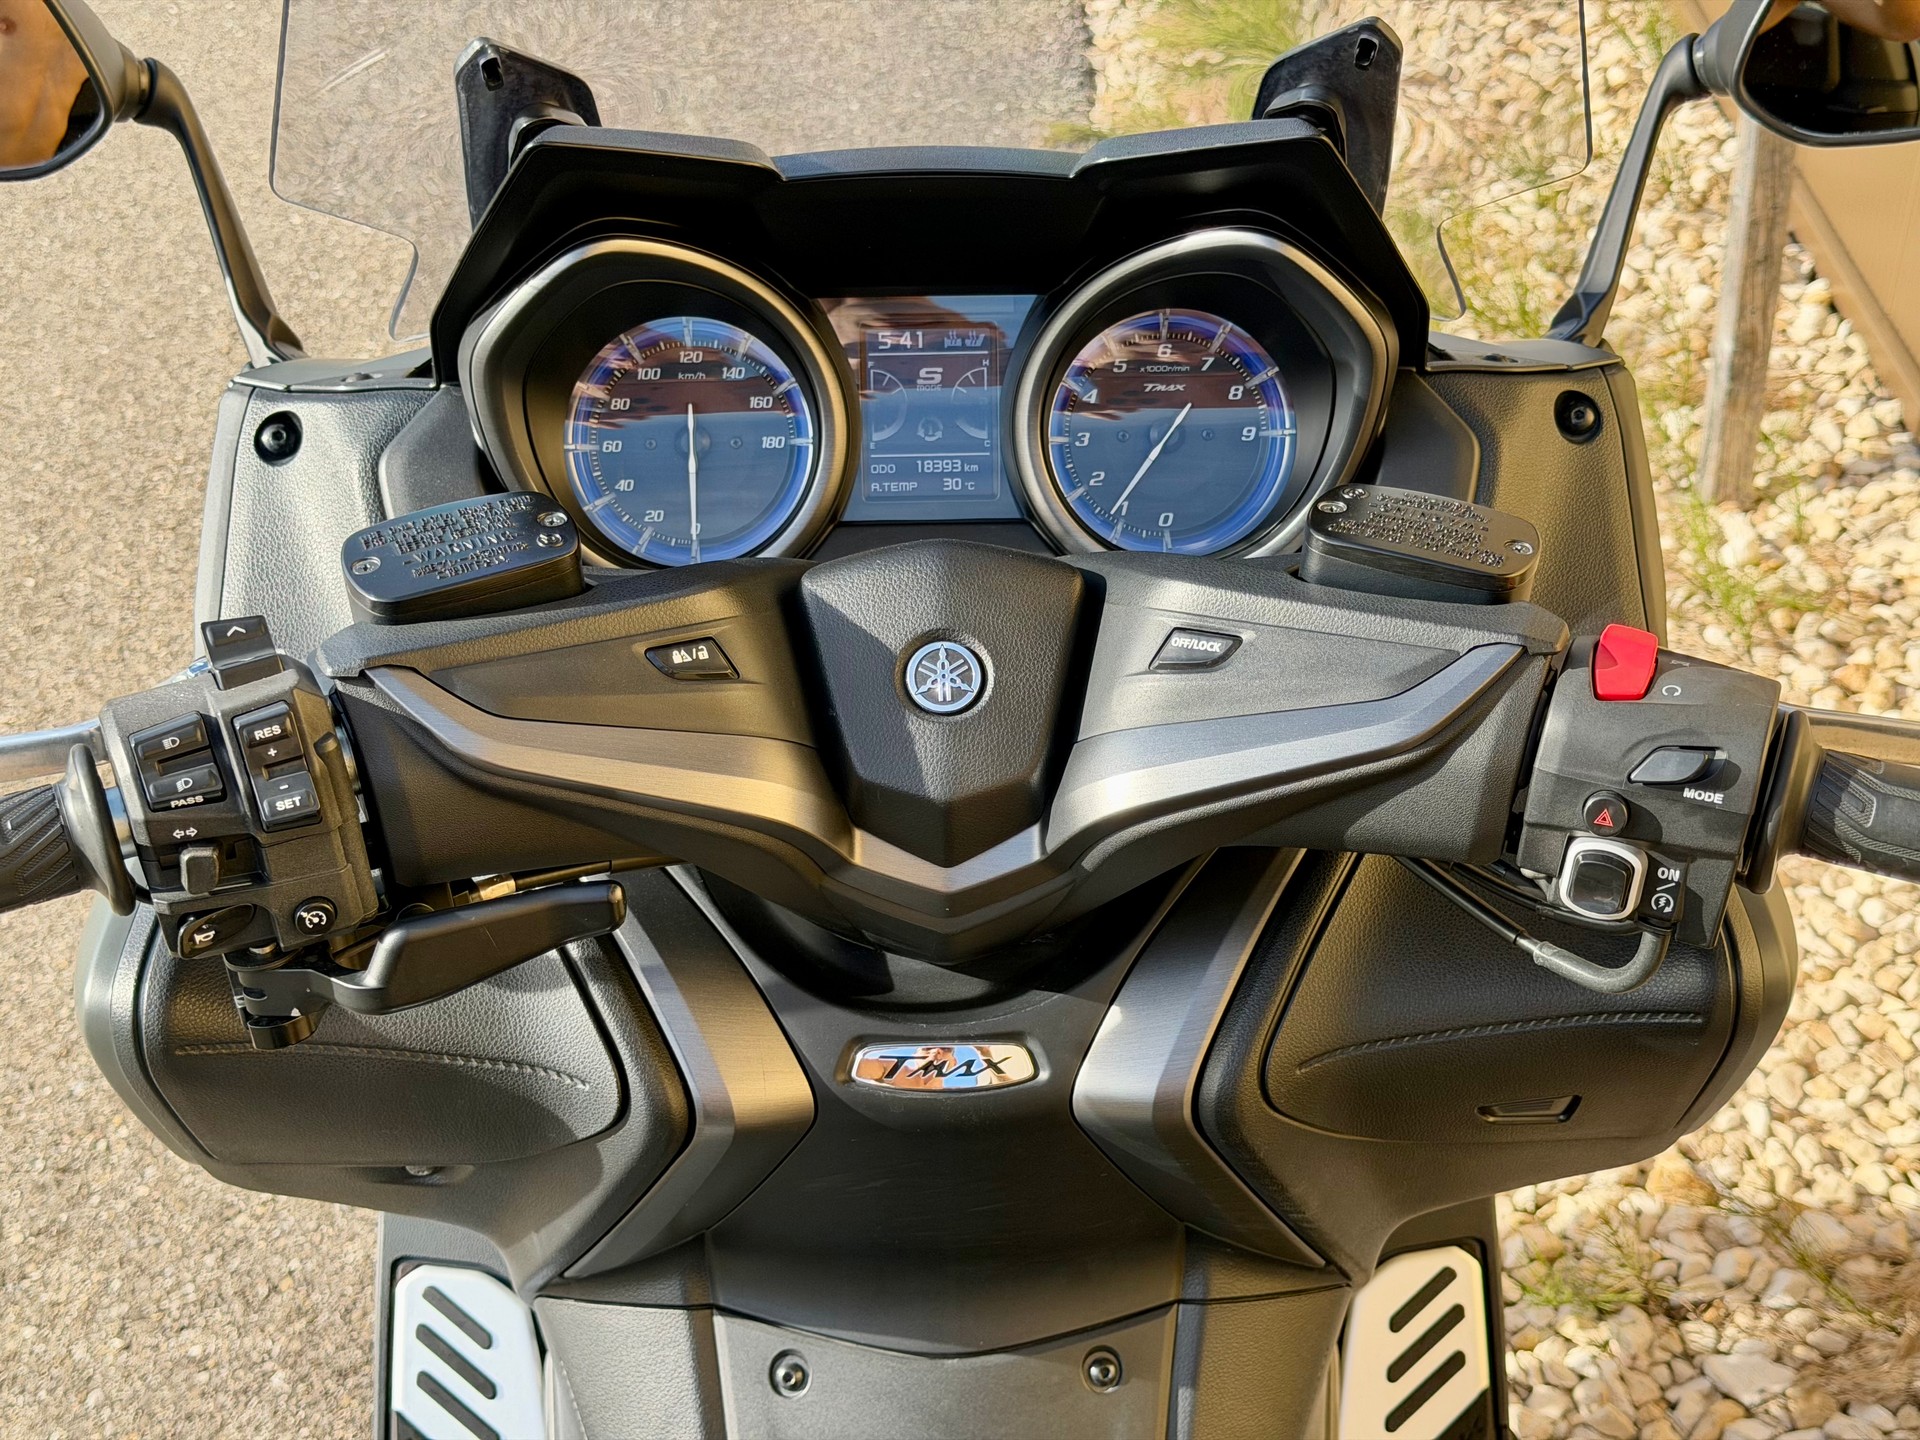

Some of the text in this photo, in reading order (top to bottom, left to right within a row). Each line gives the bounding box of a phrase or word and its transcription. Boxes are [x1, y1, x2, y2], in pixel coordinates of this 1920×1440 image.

[679, 351, 702, 364] 120
[1157, 344, 1172, 358] 6
[1112, 358, 1128, 373] 5
[1200, 357, 1216, 371] 7
[637, 368, 661, 380] 100
[678, 372, 706, 380] km/h
[722, 367, 745, 380] 140
[916, 368, 944, 384] S
[1082, 389, 1098, 404] 4
[1228, 386, 1244, 400] 8
[610, 398, 630, 411] 80
[750, 396, 773, 409] 160
[1074, 432, 1090, 446] 3
[1241, 426, 1256, 441] 9
[602, 440, 622, 453] 60
[761, 436, 786, 449] 180
[916, 460, 962, 473] 18393
[964, 463, 979, 472] km
[614, 479, 634, 492] 40
[942, 478, 962, 491] 30
[1089, 472, 1106, 486] 2
[644, 510, 664, 522] 20
[1158, 512, 1174, 527] 0
[1171, 637, 1222, 652] OFF/LOCK
[254, 724, 282, 740] RES
[170, 795, 204, 808] PASS
[1682, 787, 1724, 805] MODE
[275, 796, 302, 812] SET
[1656, 867, 1680, 882] ON
